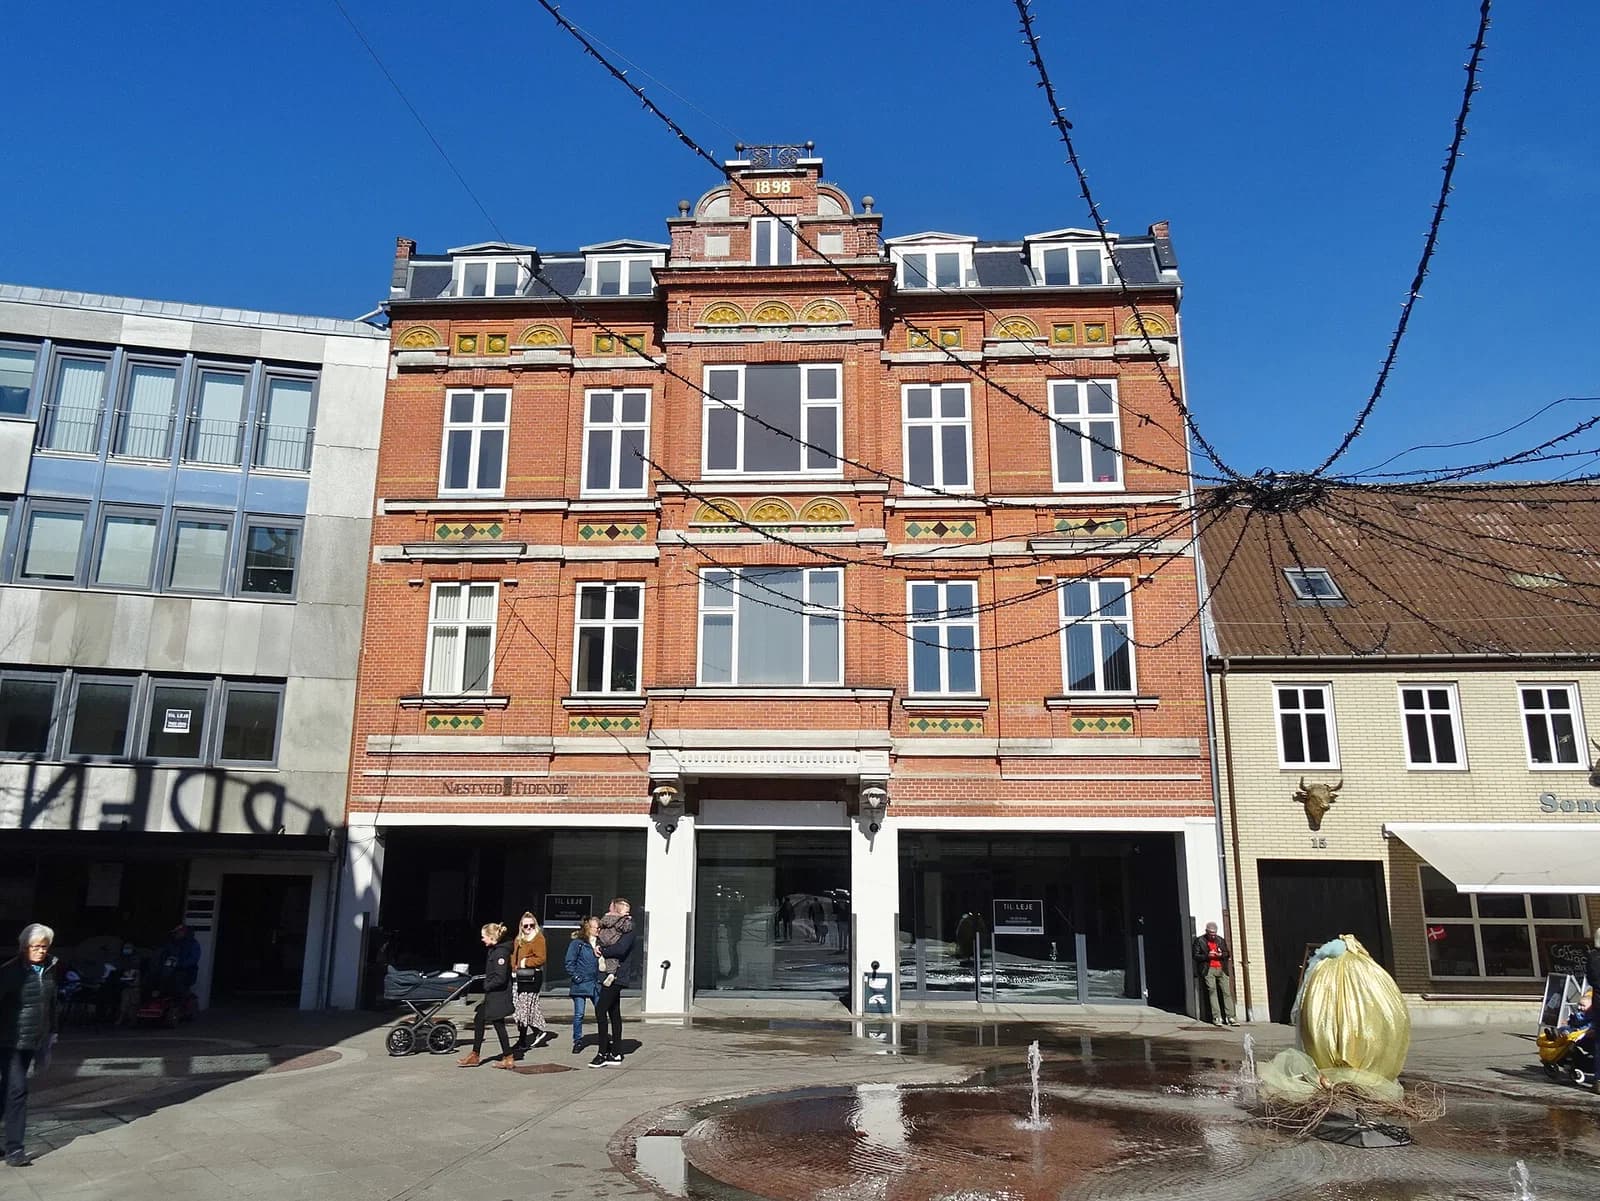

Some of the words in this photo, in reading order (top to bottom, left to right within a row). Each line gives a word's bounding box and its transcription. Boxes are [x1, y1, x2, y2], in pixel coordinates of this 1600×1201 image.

[755, 181, 791, 194] 1898
[513, 782, 568, 795] TIDENDE
[1540, 792, 1600, 813] Son
[1311, 838, 1327, 849] 15
[1003, 903, 1014, 911] TIL
[1015, 903, 1033, 911] LEJE
